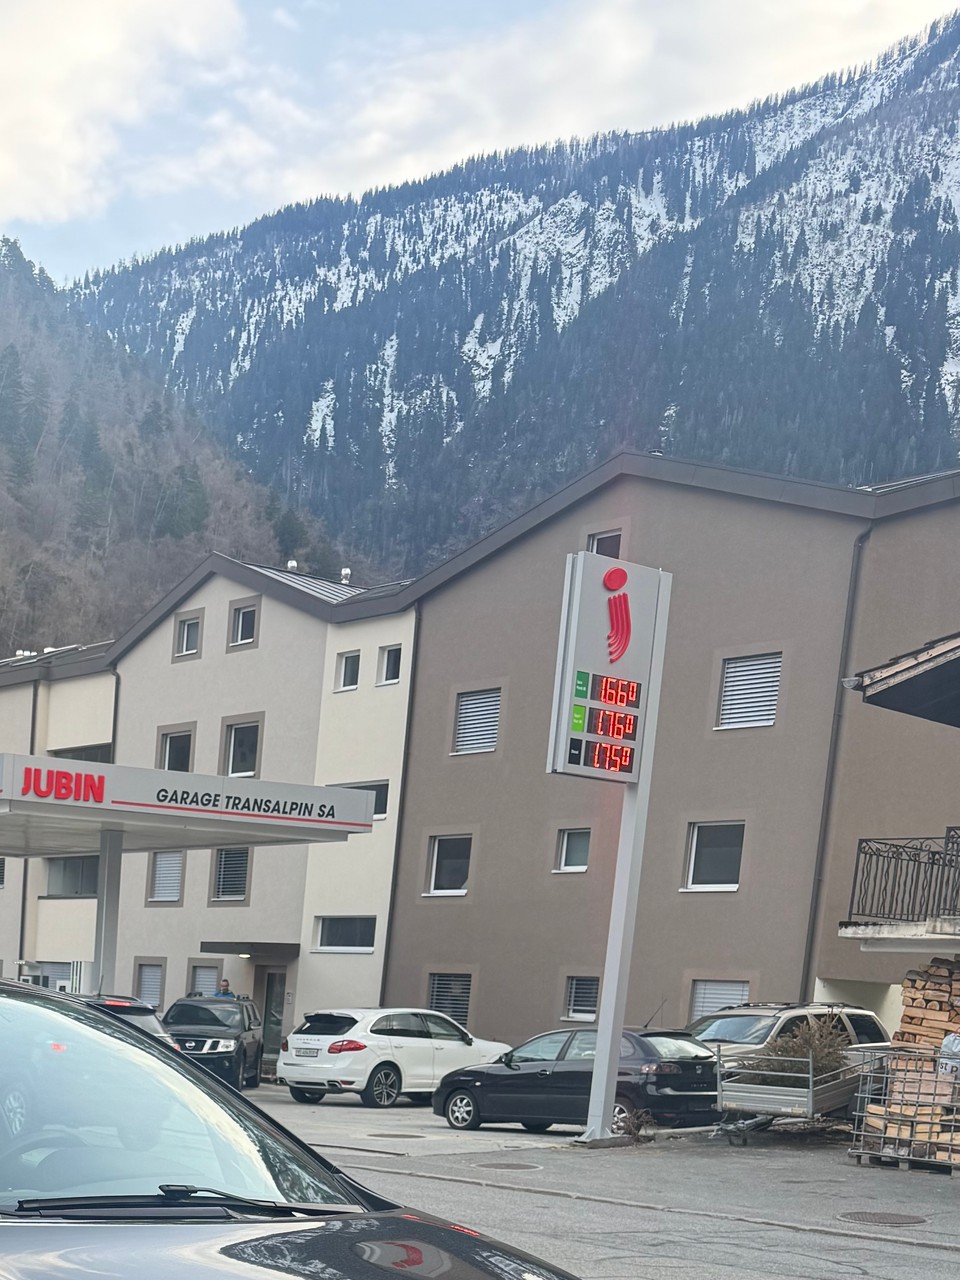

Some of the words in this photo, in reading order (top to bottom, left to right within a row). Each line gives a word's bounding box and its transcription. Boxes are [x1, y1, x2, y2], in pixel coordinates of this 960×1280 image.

[21, 766, 106, 803] JUBIN
[156, 788, 221, 807] GARAGE
[224, 795, 314, 817] TRANSALPIN
[317, 804, 336, 819] SA
